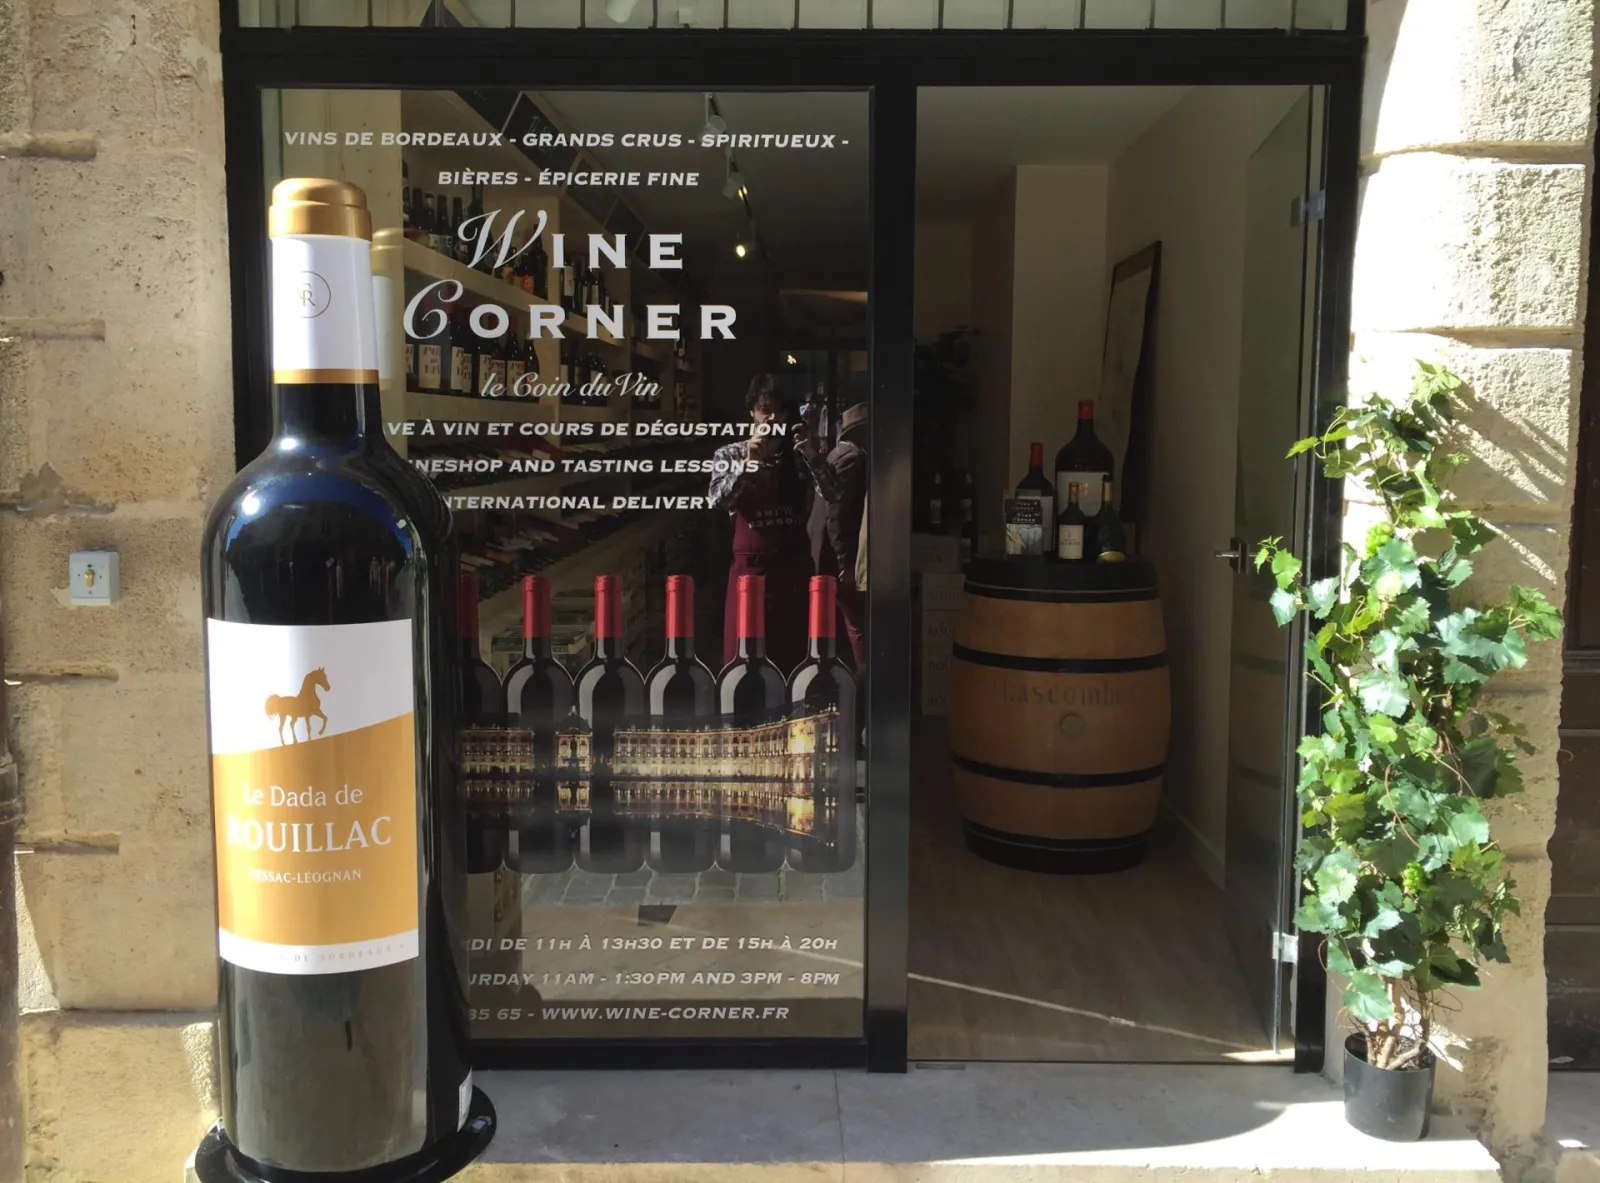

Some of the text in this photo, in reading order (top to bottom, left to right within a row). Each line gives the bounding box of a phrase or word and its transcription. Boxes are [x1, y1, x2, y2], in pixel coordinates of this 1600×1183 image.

[284, 131, 338, 146] VINS
[344, 132, 374, 146] DE
[380, 131, 503, 147] BORDEAUX
[522, 132, 615, 148] GRANDS
[621, 133, 682, 148] CRUS
[701, 133, 836, 149] SPIRITUEUX
[437, 167, 519, 186] BIÈRES
[538, 167, 641, 187] ÉPICERIE
[646, 171, 700, 187] FINE
[458, 208, 683, 270] WINE
[403, 279, 737, 341] CORNER
[480, 373, 509, 398] le
[513, 371, 576, 398] Coin
[387, 417, 788, 438] VE À VIN ET COURS DE DÉGUSTATION
[414, 459, 760, 474] NESHOP AND TASTING LESSONS
[443, 495, 717, 511] NTERNATIONAL DELIVERY
[269, 784, 328, 807] Dada
[335, 783, 365, 806] de
[226, 815, 393, 854] ROUILLAC
[471, 938, 493, 951] DI
[499, 938, 528, 951] DE
[578, 935, 592, 950] À
[669, 936, 696, 950] ET
[702, 936, 729, 950] DE
[780, 934, 793, 950] À
[469, 972, 534, 986] URDAY
[543, 972, 594, 986] 11AM
[615, 972, 686, 986] 1:30PM
[692, 972, 736, 985] AND
[741, 972, 782, 985] 3PM
[799, 972, 840, 986] 8PM
[497, 1008, 522, 1020] 65
[541, 1006, 791, 1021] WWW.WINE-CORNER.FR
